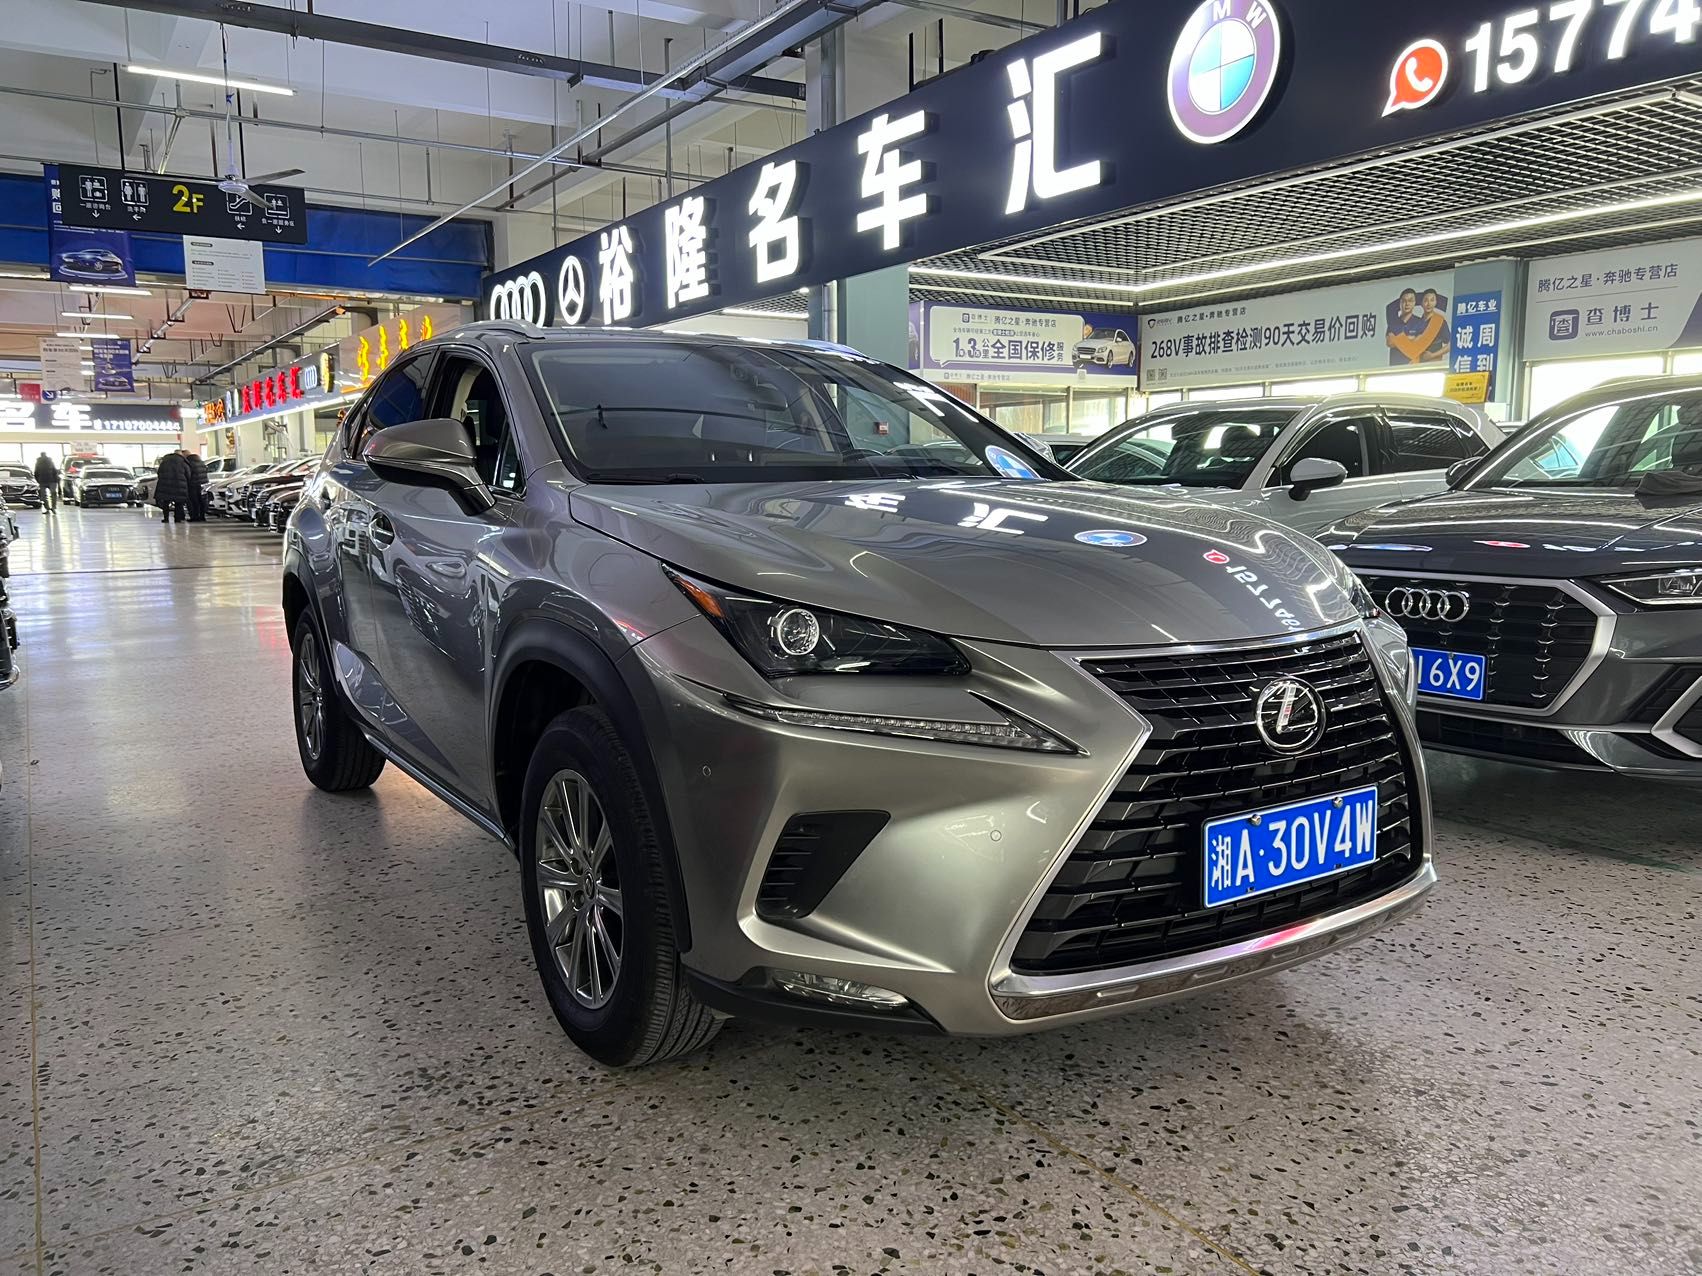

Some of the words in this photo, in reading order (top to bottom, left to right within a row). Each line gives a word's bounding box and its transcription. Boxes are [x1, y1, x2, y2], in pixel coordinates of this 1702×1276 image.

[1465, 0, 1702, 93] 15774
[172, 184, 204, 213] 2F
[599, 31, 1102, 325] 裕隆名车汇
[1457, 299, 1497, 314] 腾亿车业
[1585, 302, 1659, 326] 查博士
[1150, 311, 1377, 359] 268V事故排查检测90天交易价回购
[1455, 325, 1473, 373] 诚信
[1477, 323, 1496, 372] 周到
[1584, 325, 1659, 337] www.chaboshi.cn
[1417, 655, 1480, 691] 16X9
[1211, 799, 1373, 891] 湘A·30V4W
